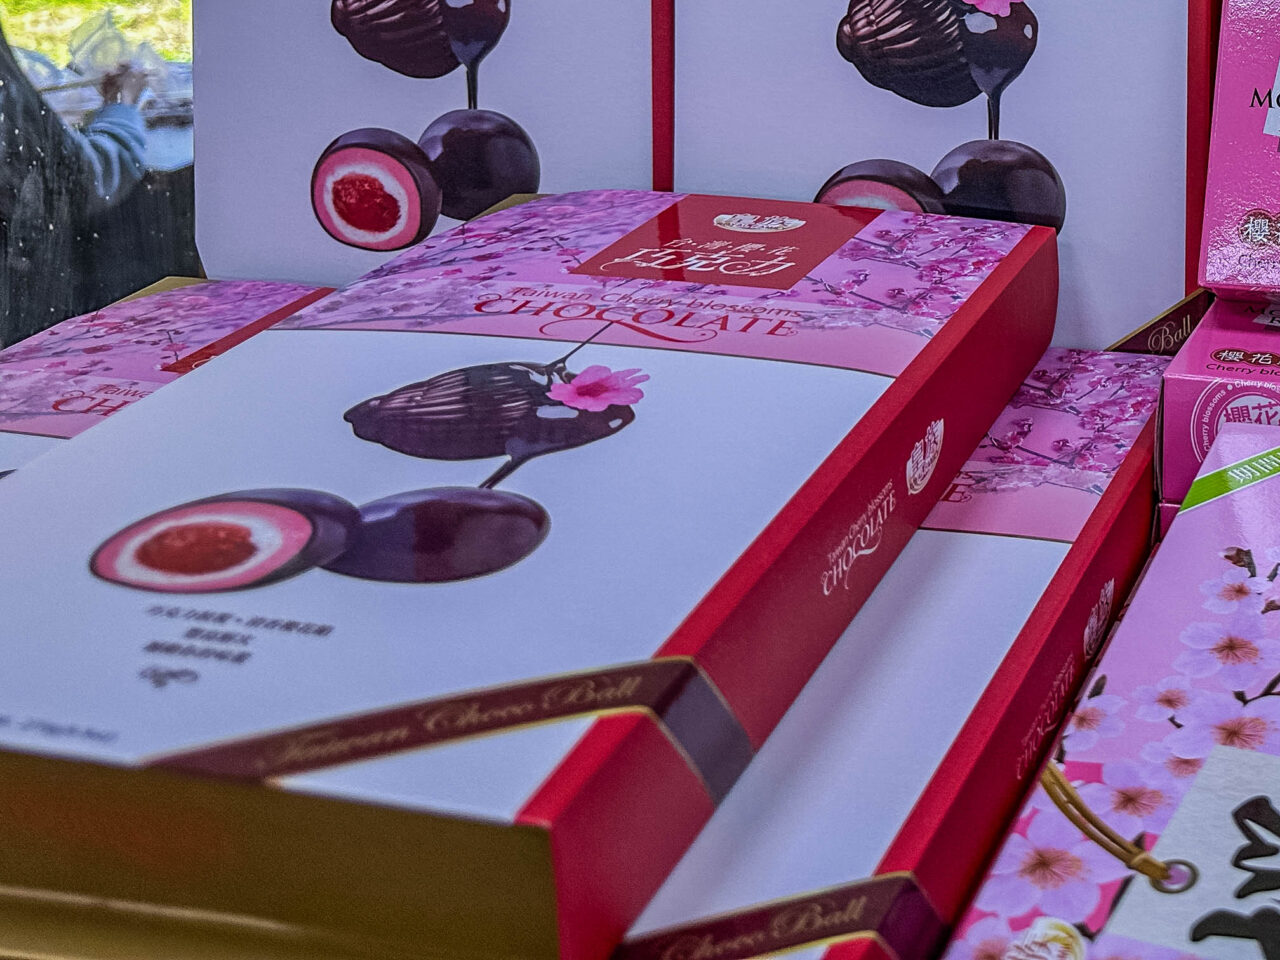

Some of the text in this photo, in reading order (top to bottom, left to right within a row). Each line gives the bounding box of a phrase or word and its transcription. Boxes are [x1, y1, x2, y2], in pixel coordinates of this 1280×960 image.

[601, 248, 796, 277] 巧克力
[474, 294, 801, 338] CHOCOLATE
[510, 287, 803, 319] Taiwan Cherry blossoms
[1147, 314, 1193, 355] Ball
[1206, 363, 1257, 376] Cherry
[1202, 389, 1227, 424] blossoms
[820, 489, 897, 596] CHOCOLATE
[541, 675, 644, 712] Ball
[770, 895, 868, 939] Ball
